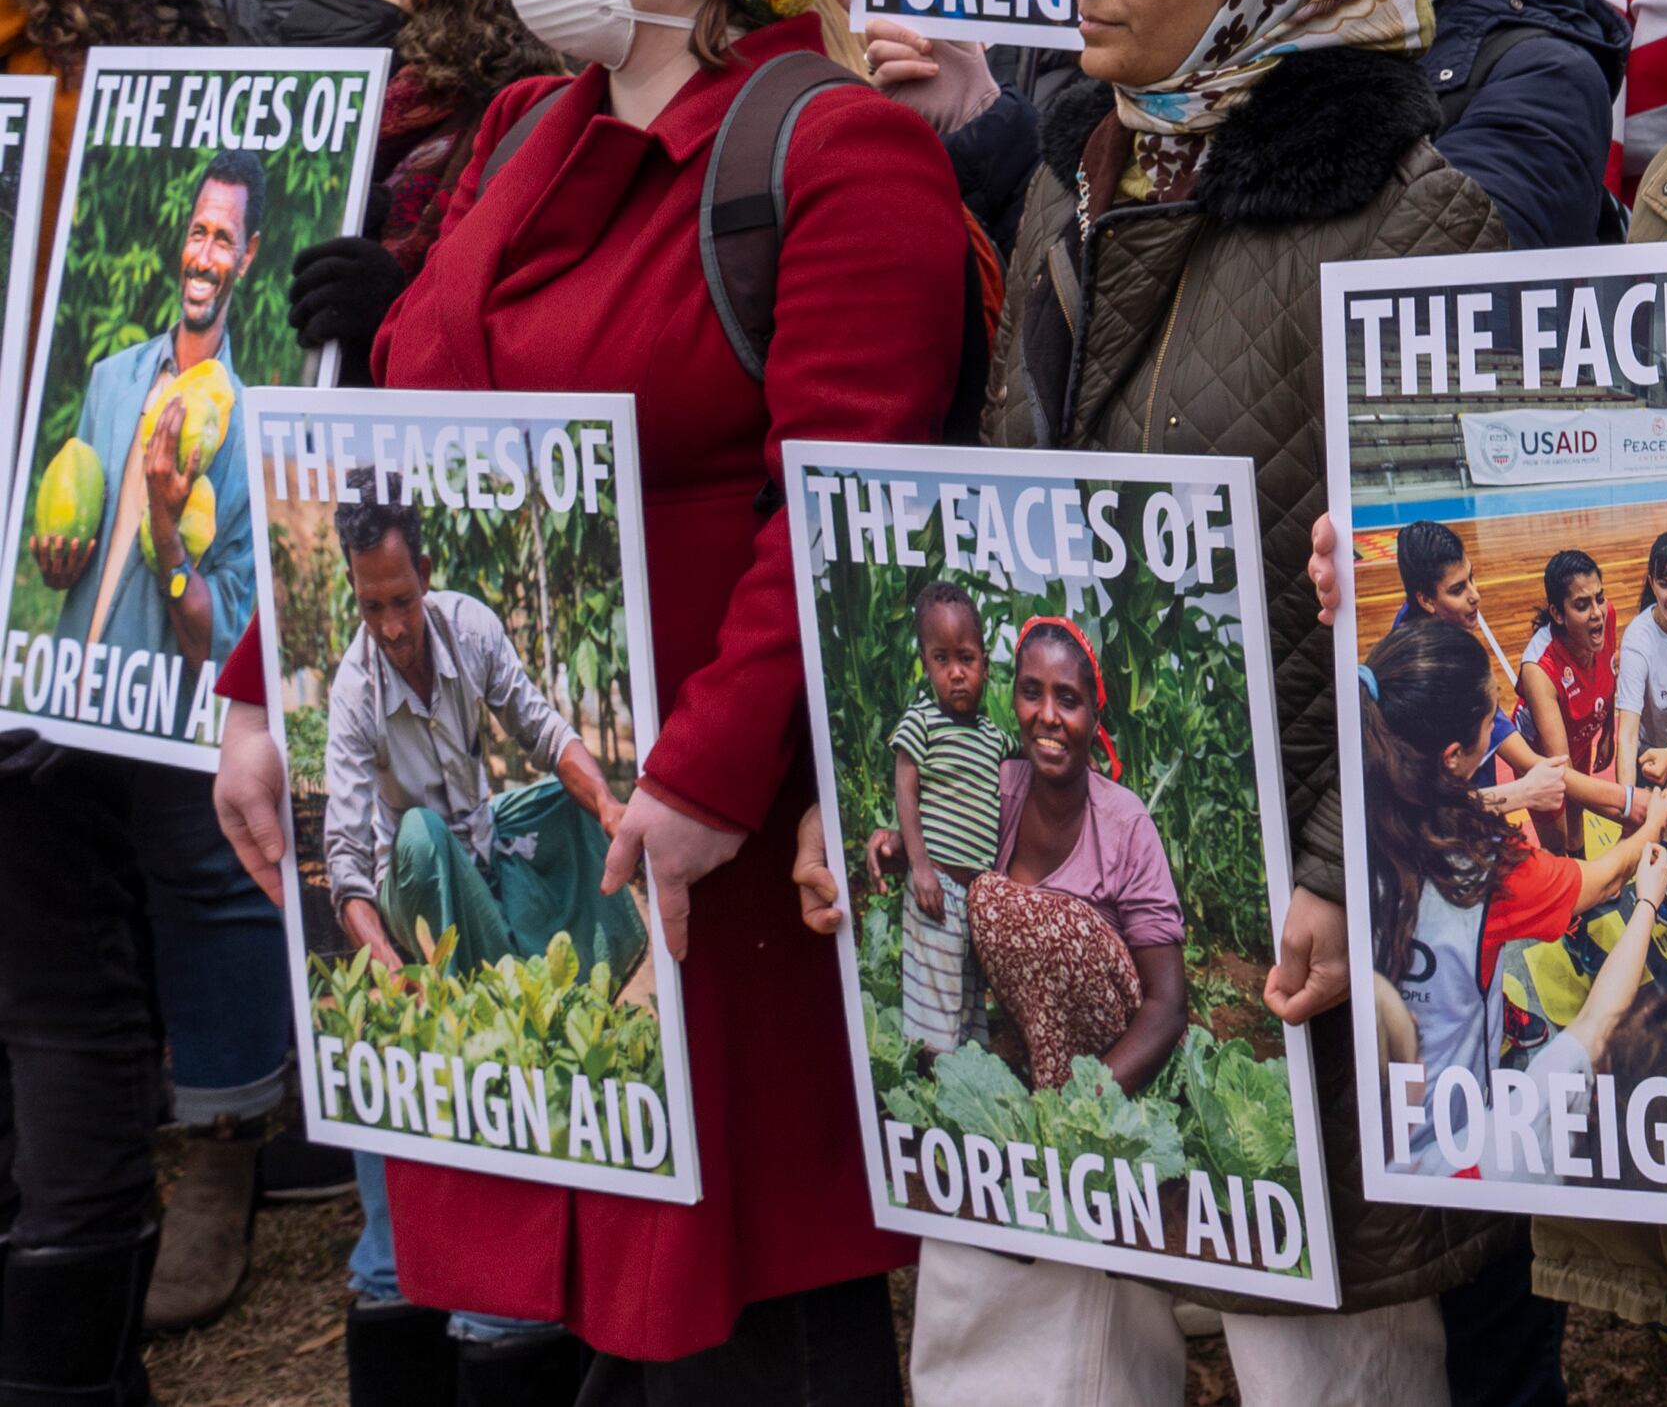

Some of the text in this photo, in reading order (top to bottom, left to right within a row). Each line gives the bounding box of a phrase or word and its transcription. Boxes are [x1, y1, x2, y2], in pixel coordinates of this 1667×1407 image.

[94, 75, 364, 154] THE FACES OF
[1350, 292, 1497, 397] THE
[263, 420, 609, 514] THE FACES OF
[1521, 430, 1597, 456] USAID
[807, 475, 1230, 585] THE FACES OF
[0, 630, 183, 737] FOREIGN
[318, 1035, 668, 1171] FOREIGN AID
[884, 1118, 1302, 1271] FOREIGN AID
